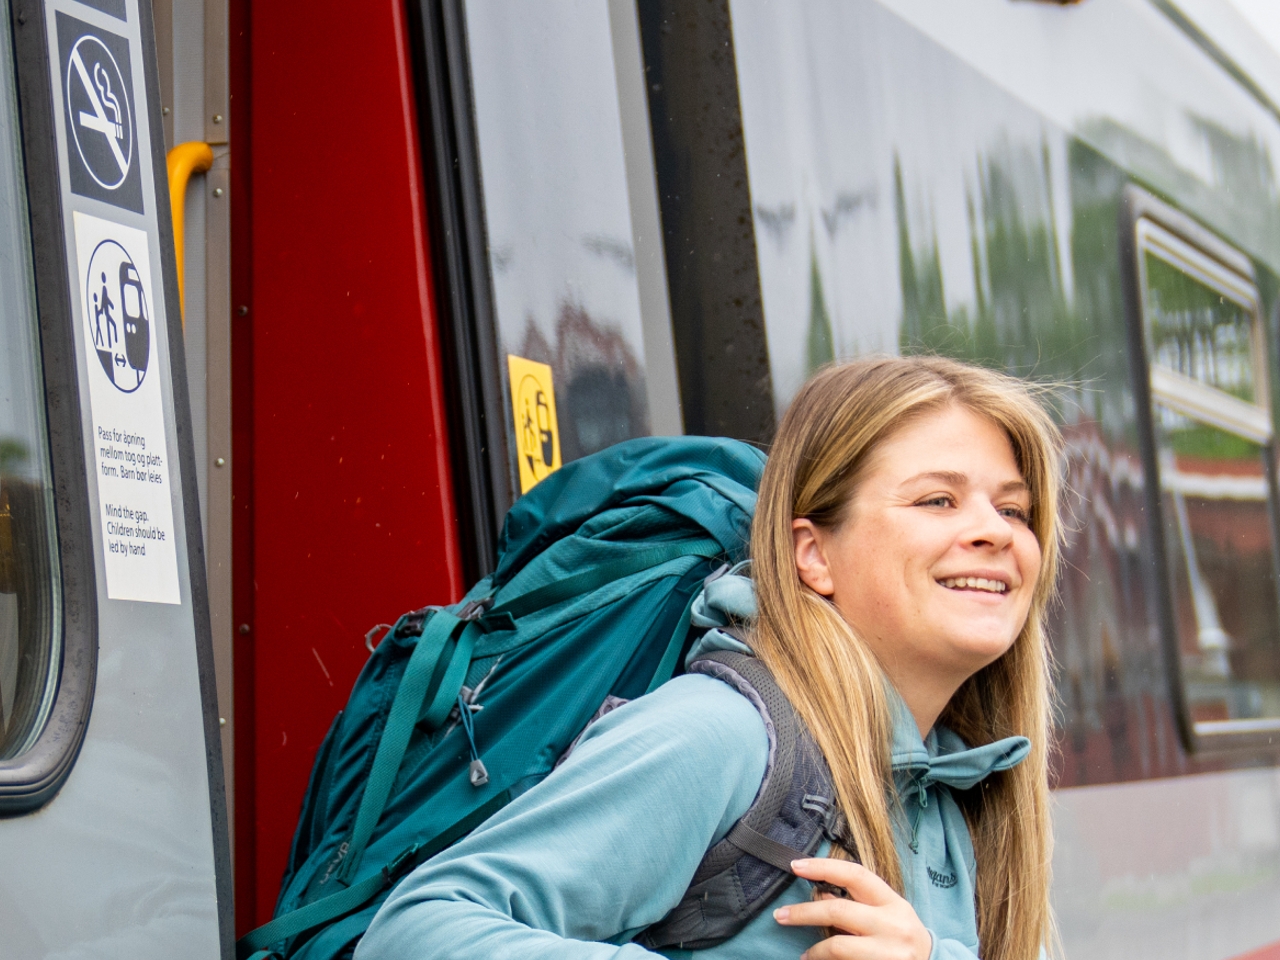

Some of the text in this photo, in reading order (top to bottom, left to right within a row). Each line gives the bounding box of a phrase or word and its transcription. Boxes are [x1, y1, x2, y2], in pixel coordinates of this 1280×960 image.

[98, 425, 145, 450] Pass for åpning
[100, 445, 162, 468] mellom tog og platt-
[101, 462, 162, 484] form. Barn bør leies
[105, 503, 149, 524] Mind the gap.
[107, 521, 165, 541] Children should be
[108, 539, 145, 557] led by hand
